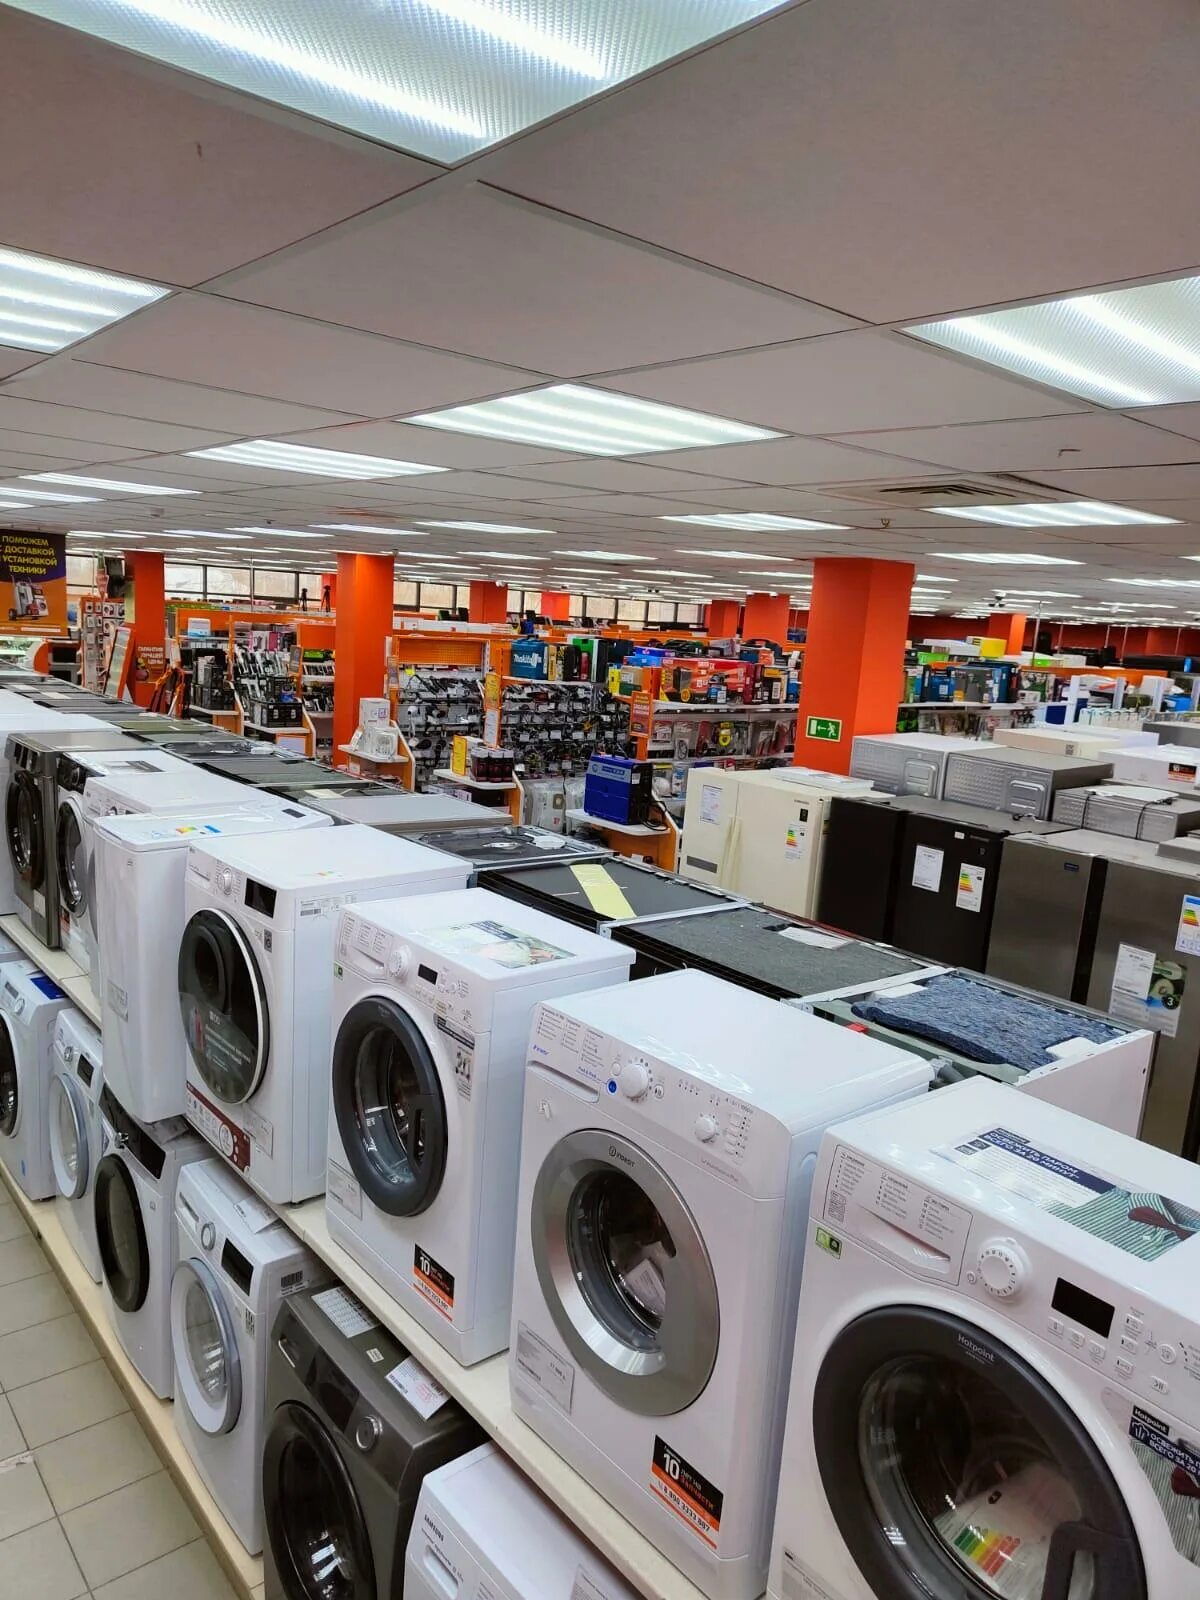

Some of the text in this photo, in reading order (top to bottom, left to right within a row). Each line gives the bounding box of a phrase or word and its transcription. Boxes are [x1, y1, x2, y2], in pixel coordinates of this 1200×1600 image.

[2, 535, 49, 546] ПОМОЖЕМ
[5, 545, 55, 557] ДОСТАВКОЙ
[2, 554, 58, 567] УСТАНОВКОЙ
[9, 565, 47, 575] ТЕХНИКИ
[1167, 996, 1174, 1006] 3
[983, 1134, 1013, 1149] ВСЕГО
[990, 1132, 1079, 1174] ОСВЕЖИТЬ ПАРОМ
[419, 1256, 430, 1276] 10
[958, 1333, 995, 1362] Hotpoint
[1135, 1408, 1167, 1432] Hotpoint
[1149, 1440, 1197, 1473] ВСЕГО ЗА 20
[1150, 1433, 1195, 1465] ОСВЕЖИТЬ
[663, 1453, 680, 1480] 10
[424, 1513, 445, 1543] SAMSUNG
